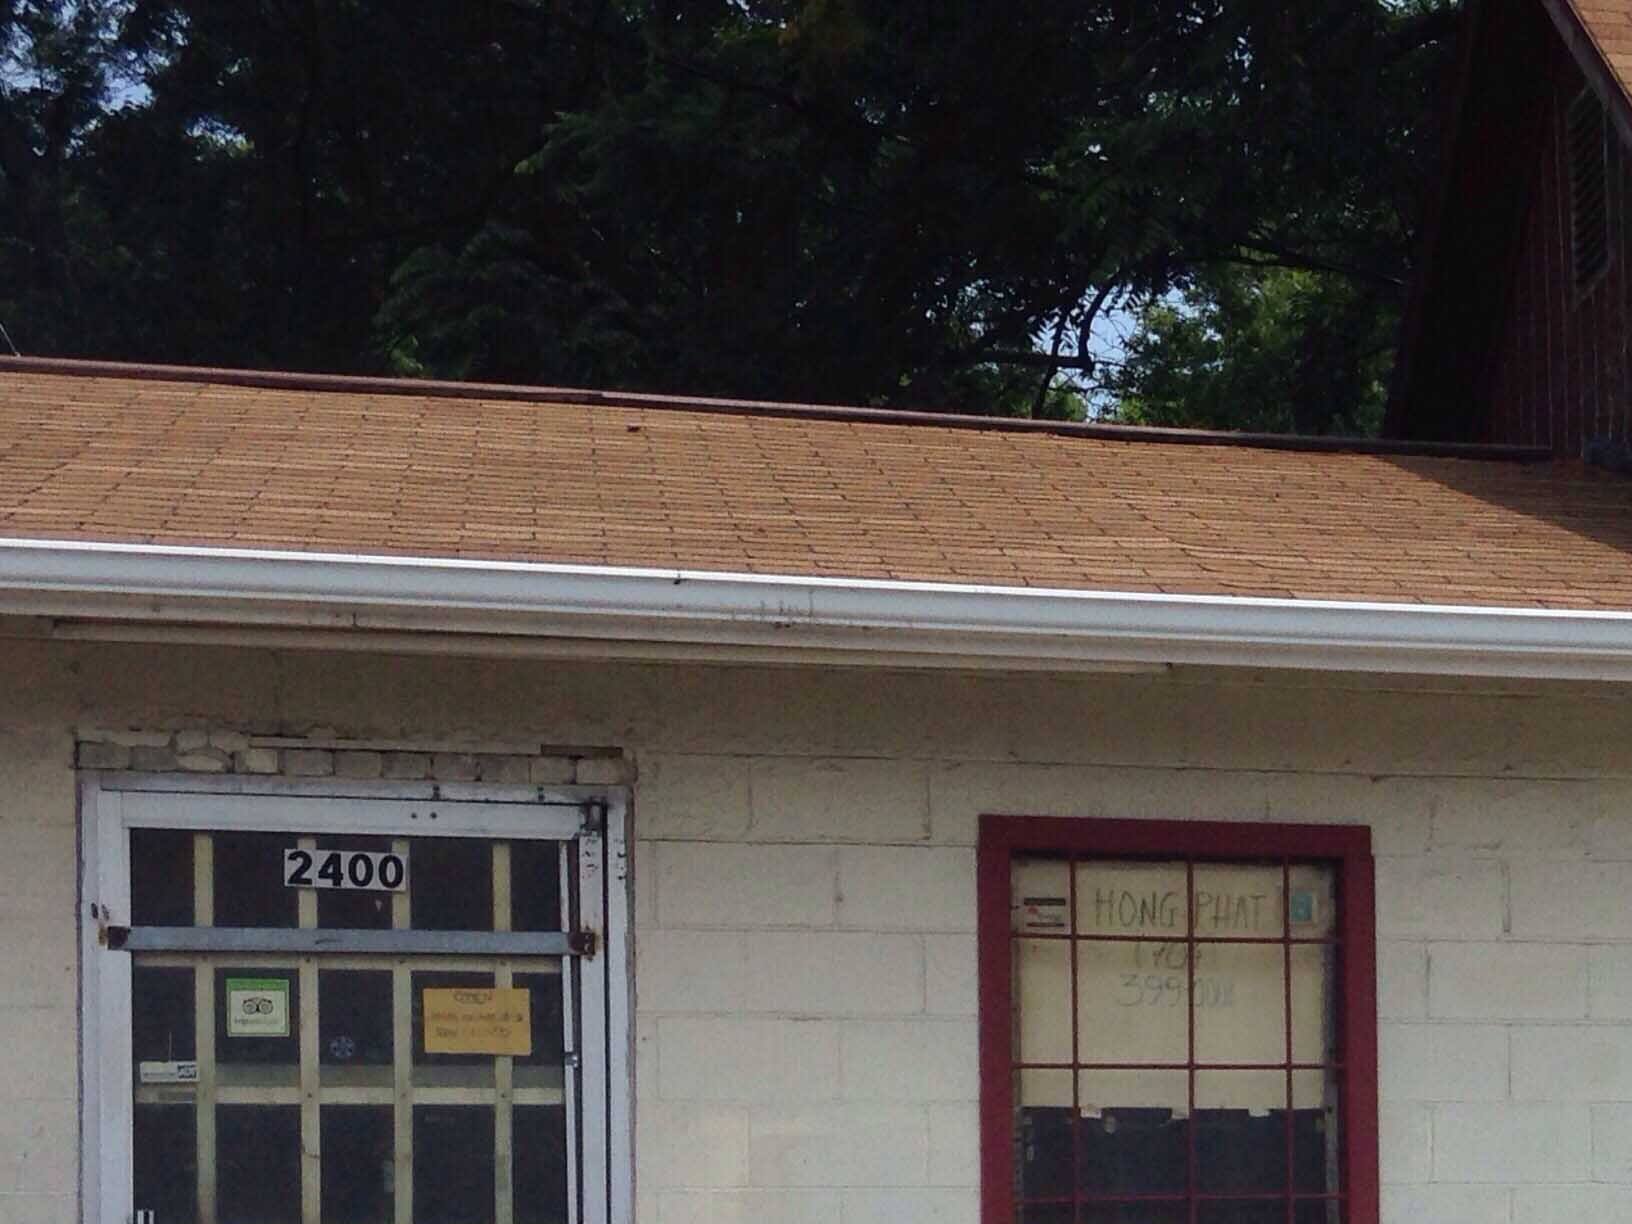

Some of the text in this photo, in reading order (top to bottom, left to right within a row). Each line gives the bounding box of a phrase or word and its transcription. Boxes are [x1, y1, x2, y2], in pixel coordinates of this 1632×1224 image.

[286, 849, 404, 889] 2400
[1095, 888, 1267, 930] HONG PHAT
